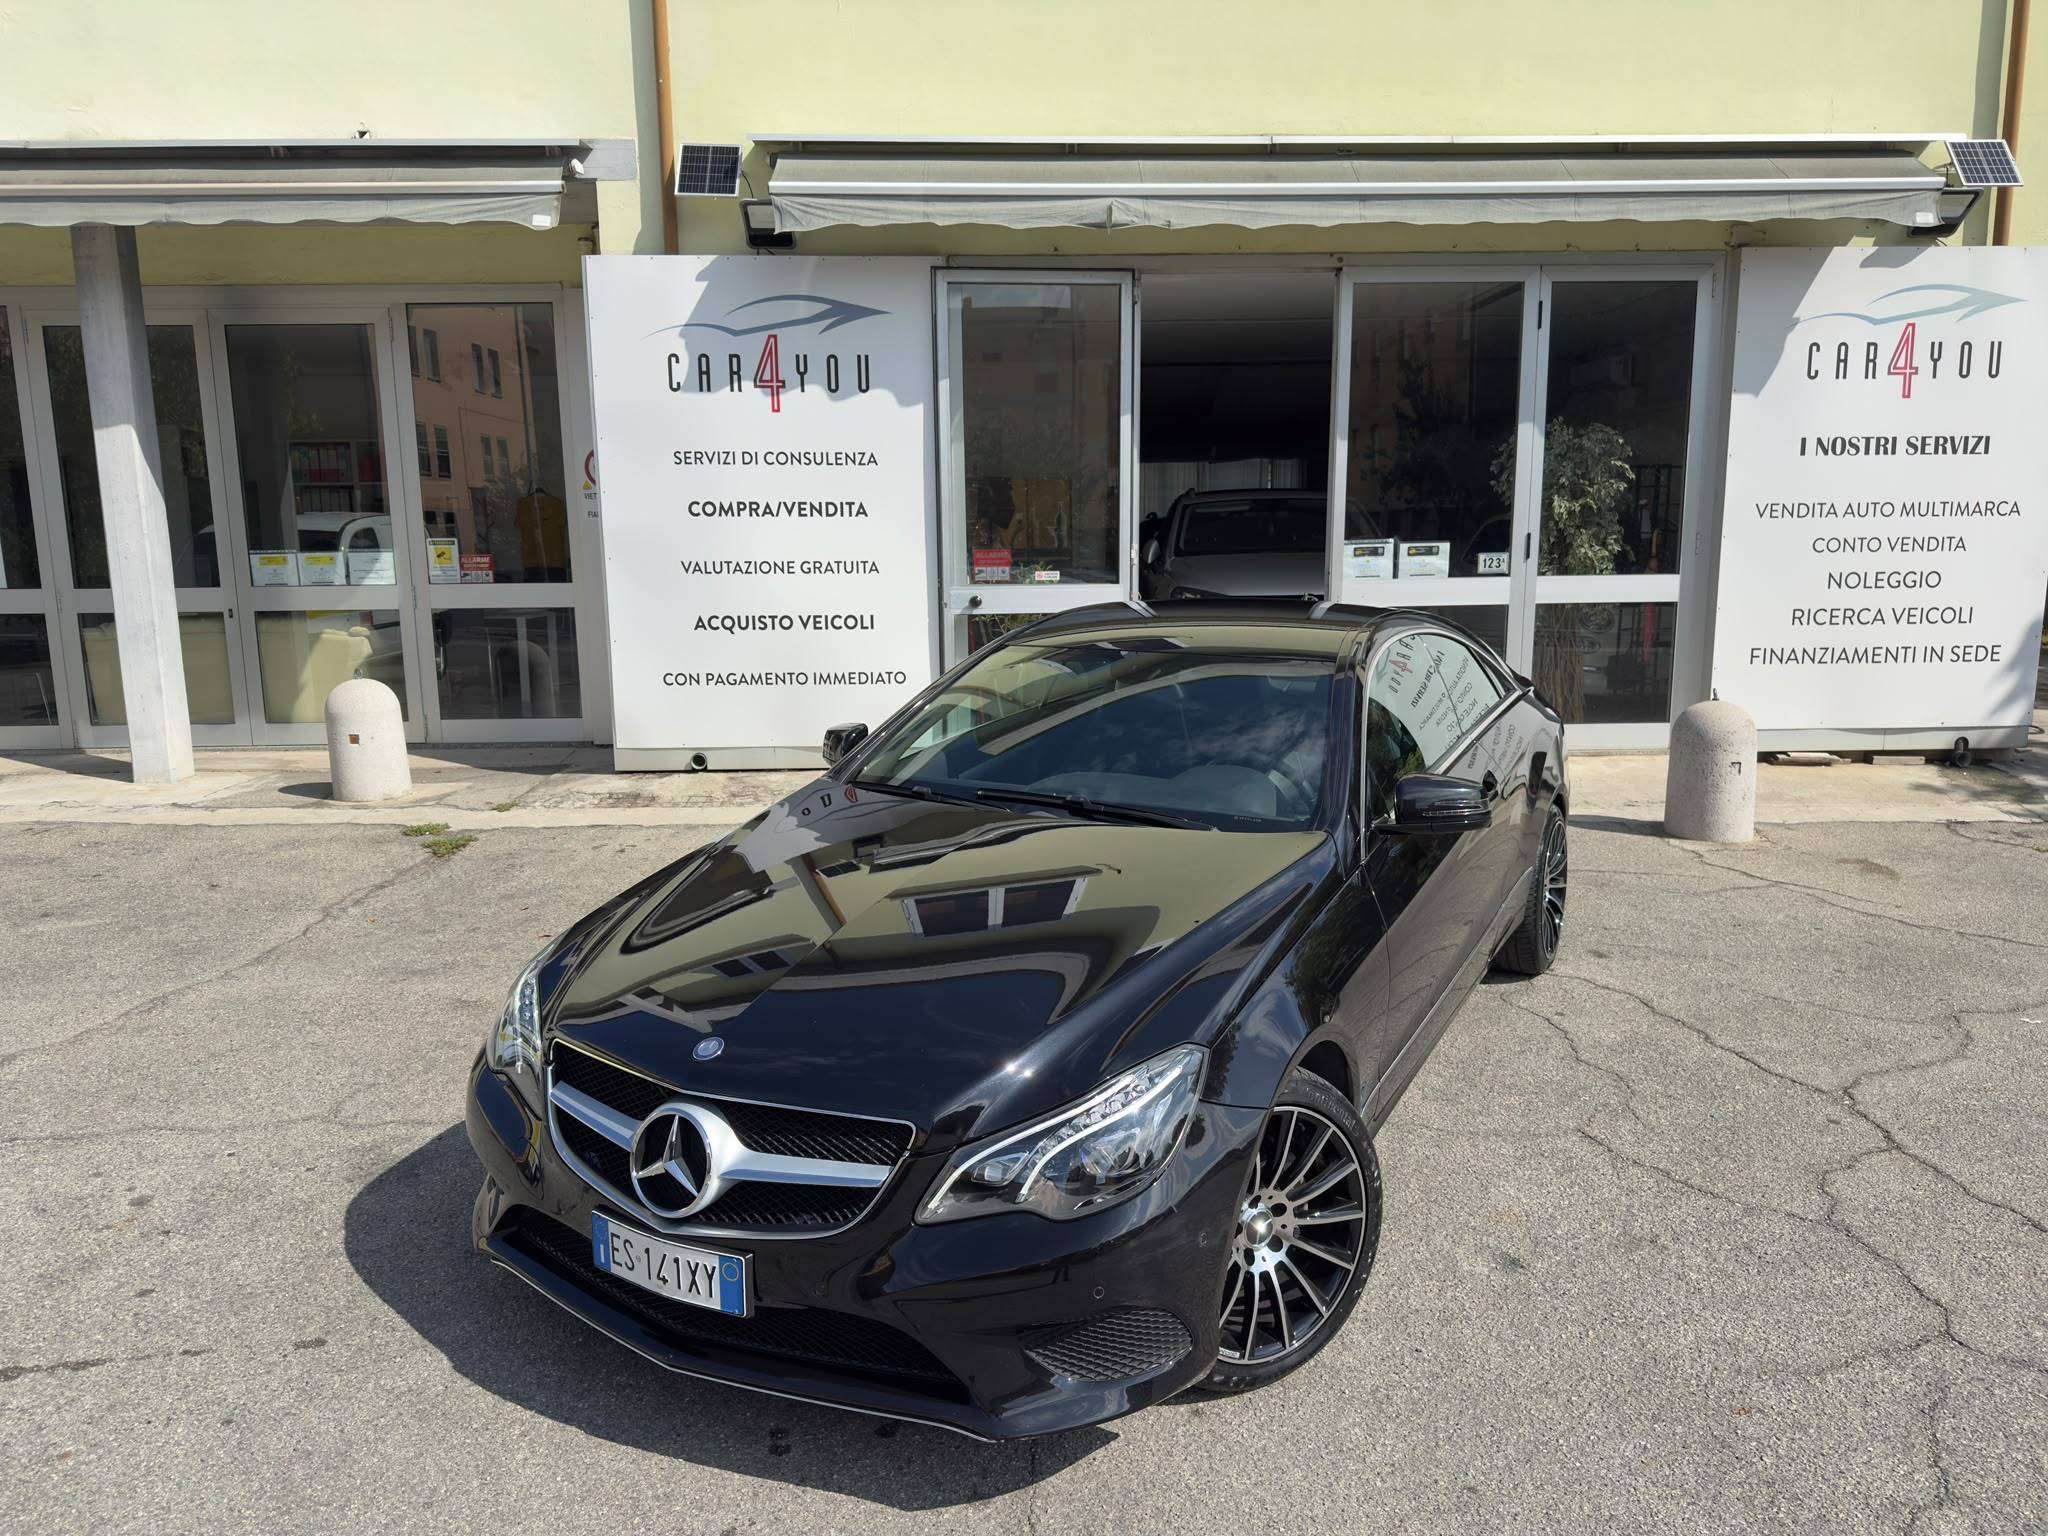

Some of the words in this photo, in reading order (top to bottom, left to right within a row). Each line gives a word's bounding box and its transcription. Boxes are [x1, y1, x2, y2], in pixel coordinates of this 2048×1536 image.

[1806, 322, 2003, 399] CAR4YOU
[667, 333, 871, 413] CAR4YOU
[1799, 436, 1807, 457] I
[1815, 436, 1898, 457] NOSTRI
[1905, 435, 1991, 456] SERVIZI
[673, 450, 736, 466] SERVIZI
[741, 451, 759, 466] DI
[763, 451, 879, 467] CONSULENZA
[687, 500, 869, 519] COMPRA/VENDITA
[1755, 502, 1839, 520] VENDITA
[1842, 501, 1895, 519] AUTO
[1899, 500, 2021, 518] MULTIMARCA
[1812, 536, 1882, 554] CONTO
[1887, 535, 1967, 553] VENDITA
[680, 560, 796, 576] VALUTAZIONE
[799, 560, 880, 576] GRATUITA
[1827, 570, 1942, 590] NOLEGGIO
[693, 614, 794, 636] ACQUISTO
[798, 614, 875, 632] VEICOLI
[1791, 607, 1886, 627] RICERCA
[1891, 606, 1974, 625] VEICOLI
[1749, 646, 1917, 666] FINANZIAMENTI
[1923, 645, 1944, 664] IN
[1950, 644, 2002, 663] SEDE
[662, 672, 700, 687] CON
[705, 671, 809, 687] PAGAMENTO
[813, 671, 908, 686] IMMEDIATO
[610, 1231, 635, 1272] ES
[644, 1247, 717, 1299] 141XY
